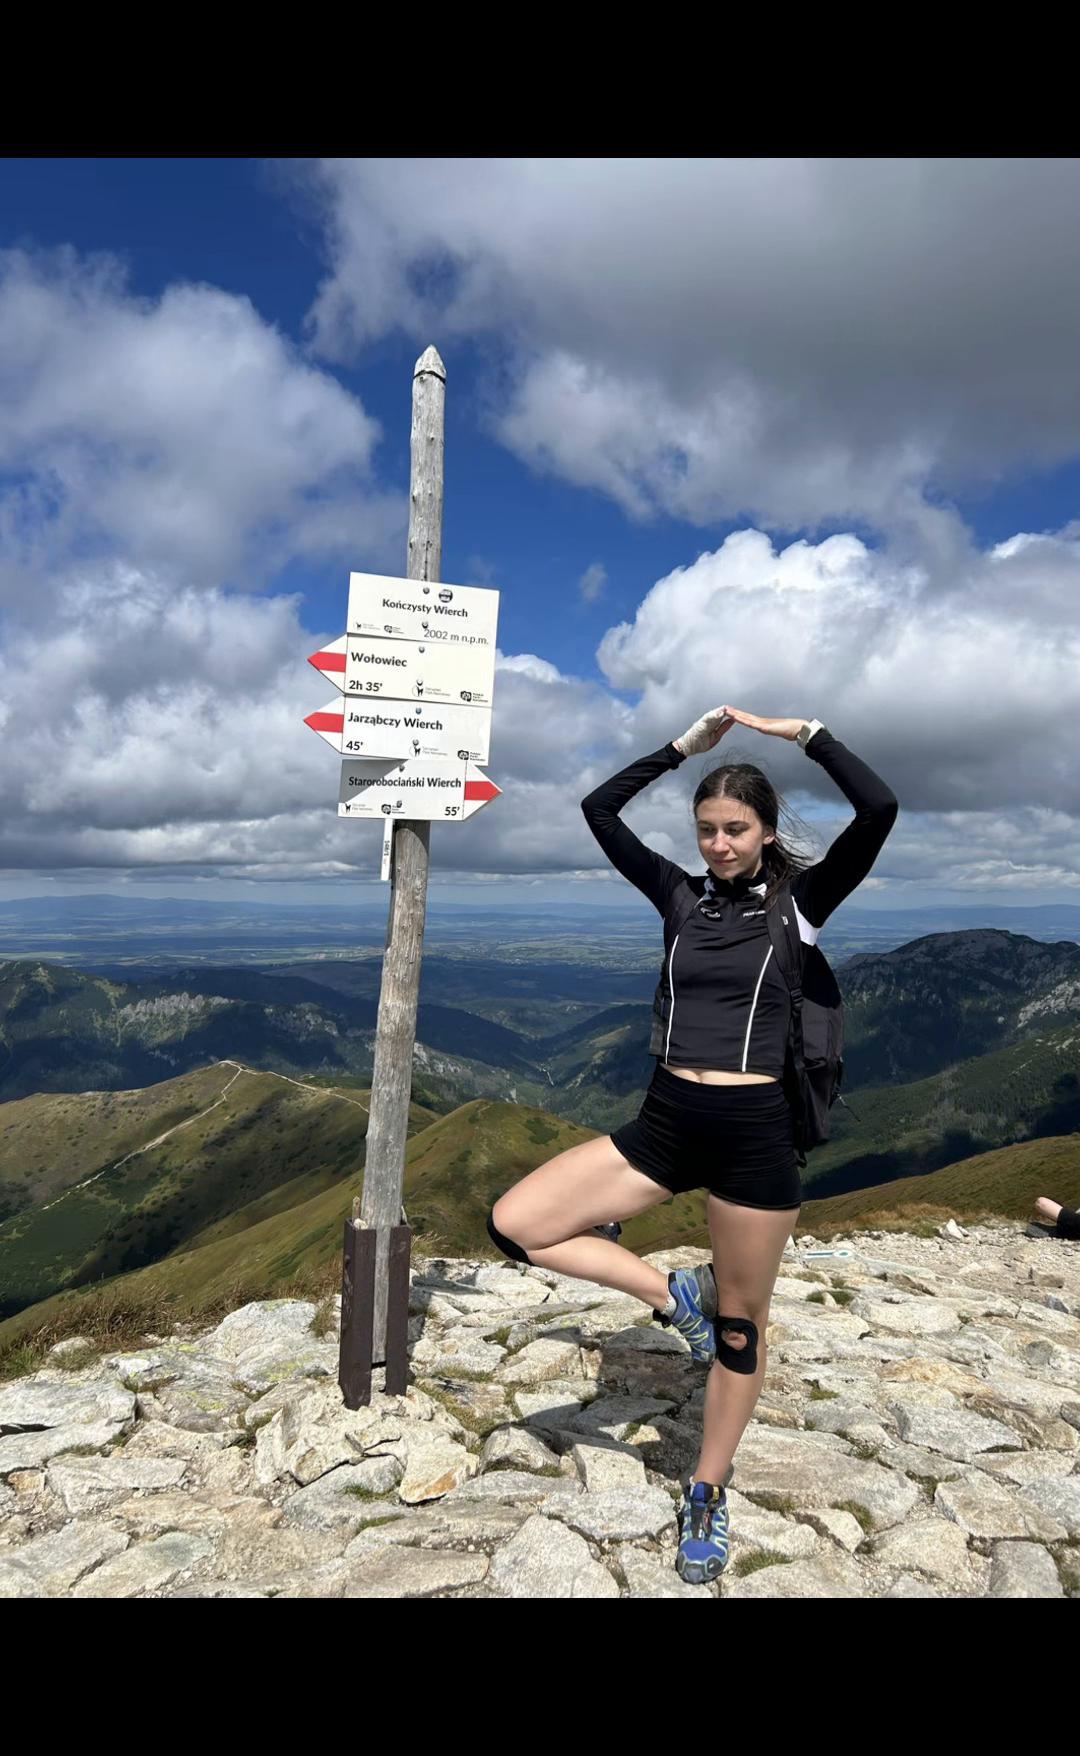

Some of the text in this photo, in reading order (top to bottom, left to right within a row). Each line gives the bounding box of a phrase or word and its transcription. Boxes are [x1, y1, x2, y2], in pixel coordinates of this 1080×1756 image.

[382, 598, 468, 618] Kończysty Wierch
[423, 627, 490, 646] 2002 m n.p.m.
[351, 652, 408, 668] Wołowiec
[349, 679, 363, 691] 2h
[348, 712, 443, 731] Jarząbczy Wierch
[348, 775, 462, 788] Starorobociański Wierch
